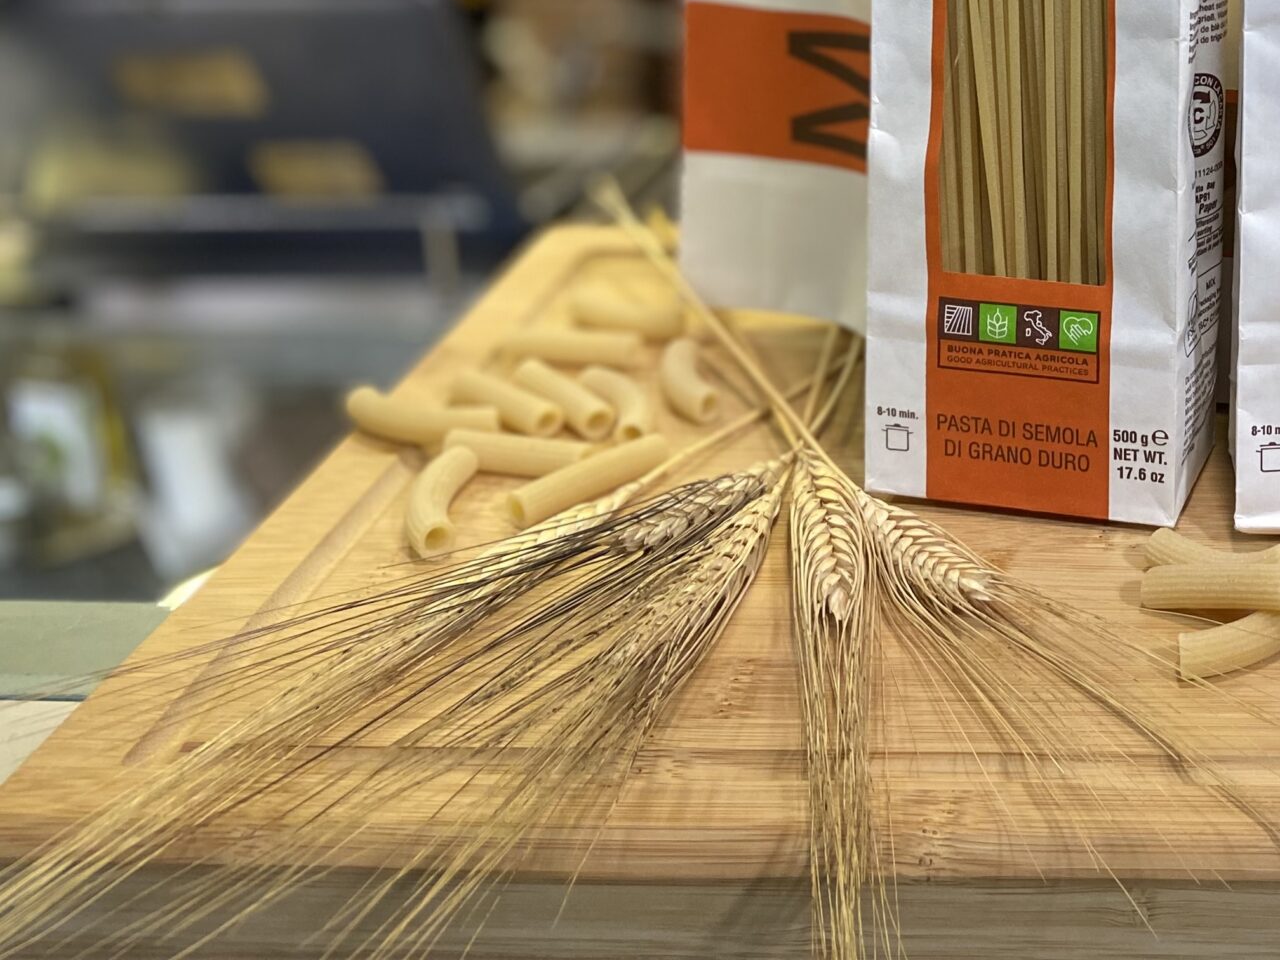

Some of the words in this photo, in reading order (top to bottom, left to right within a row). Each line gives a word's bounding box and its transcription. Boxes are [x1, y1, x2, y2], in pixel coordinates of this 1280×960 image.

[947, 344, 984, 355] BUONA
[987, 348, 1032, 360] PRATICA
[1035, 353, 1089, 366] AGRICOLA
[946, 355, 973, 365] GOOD
[975, 357, 1039, 371] AGRICULTURAL
[1041, 364, 1089, 376] PRACTICES
[877, 406, 897, 417] 8-10
[899, 409, 919, 420] min.
[936, 413, 992, 436] PASTA
[999, 419, 1016, 438] DI
[1022, 422, 1098, 448] SEMOLA
[1113, 429, 1137, 443] 500
[1141, 434, 1148, 447] g
[1251, 424, 1272, 436] 8-10
[944, 439, 961, 457] DI
[968, 441, 1032, 465] GRANO
[1038, 449, 1090, 472] DURO
[1113, 447, 1139, 462] NET
[1143, 450, 1167, 465] WT.
[1117, 466, 1147, 481] 17.6
[1150, 471, 1165, 484] oz
